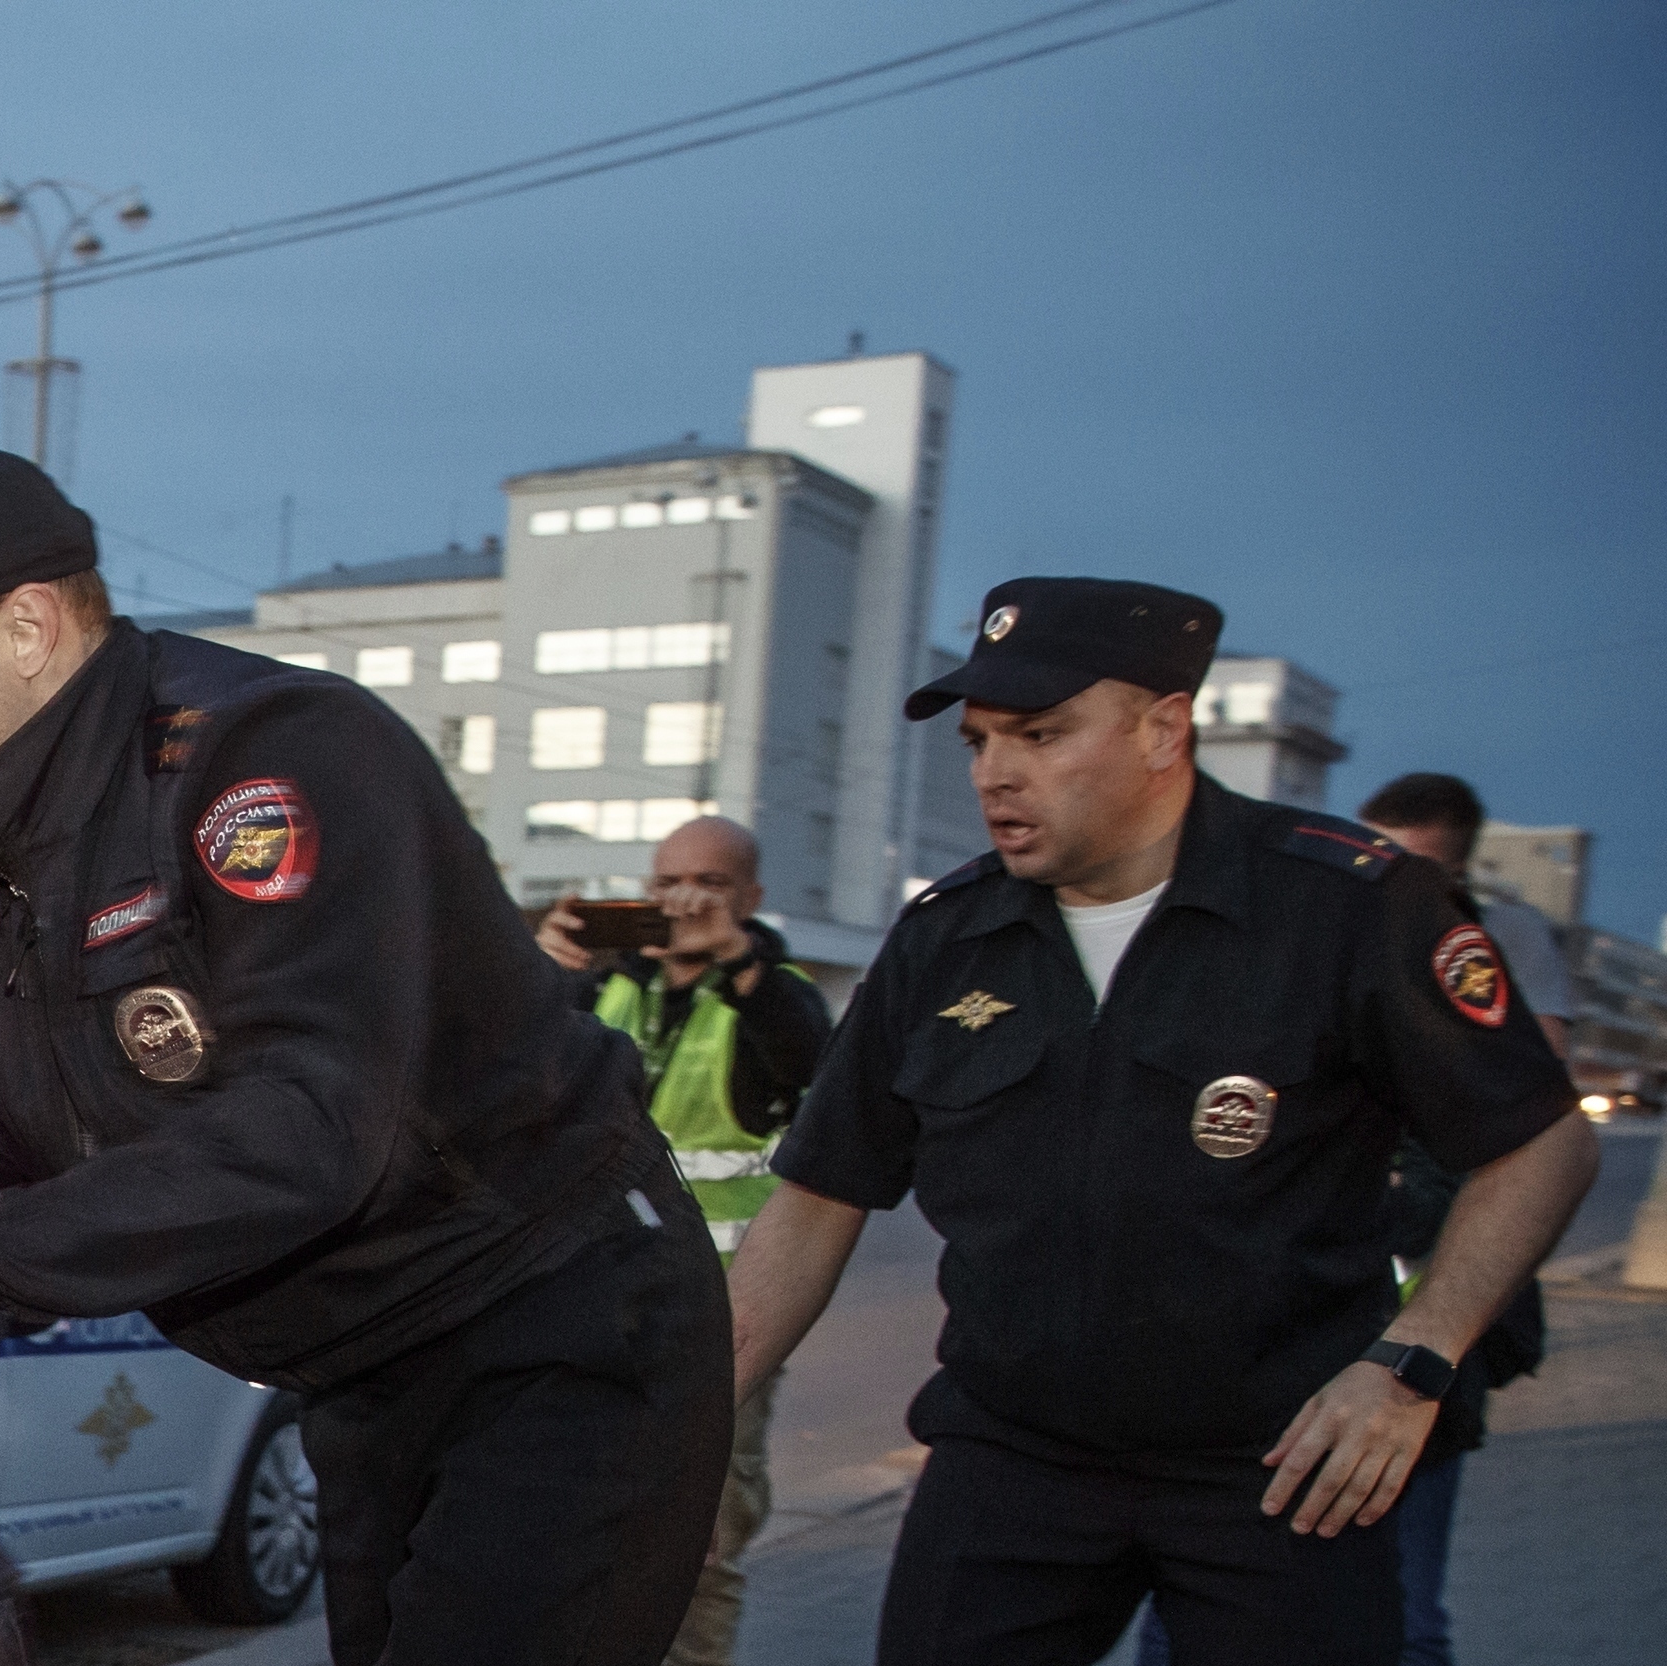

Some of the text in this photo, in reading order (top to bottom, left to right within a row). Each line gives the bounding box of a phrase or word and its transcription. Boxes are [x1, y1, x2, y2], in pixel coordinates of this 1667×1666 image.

[198, 786, 272, 843] ПОЛИЦИЯ
[209, 806, 278, 862] РОССИЯ
[255, 874, 285, 897] МВД
